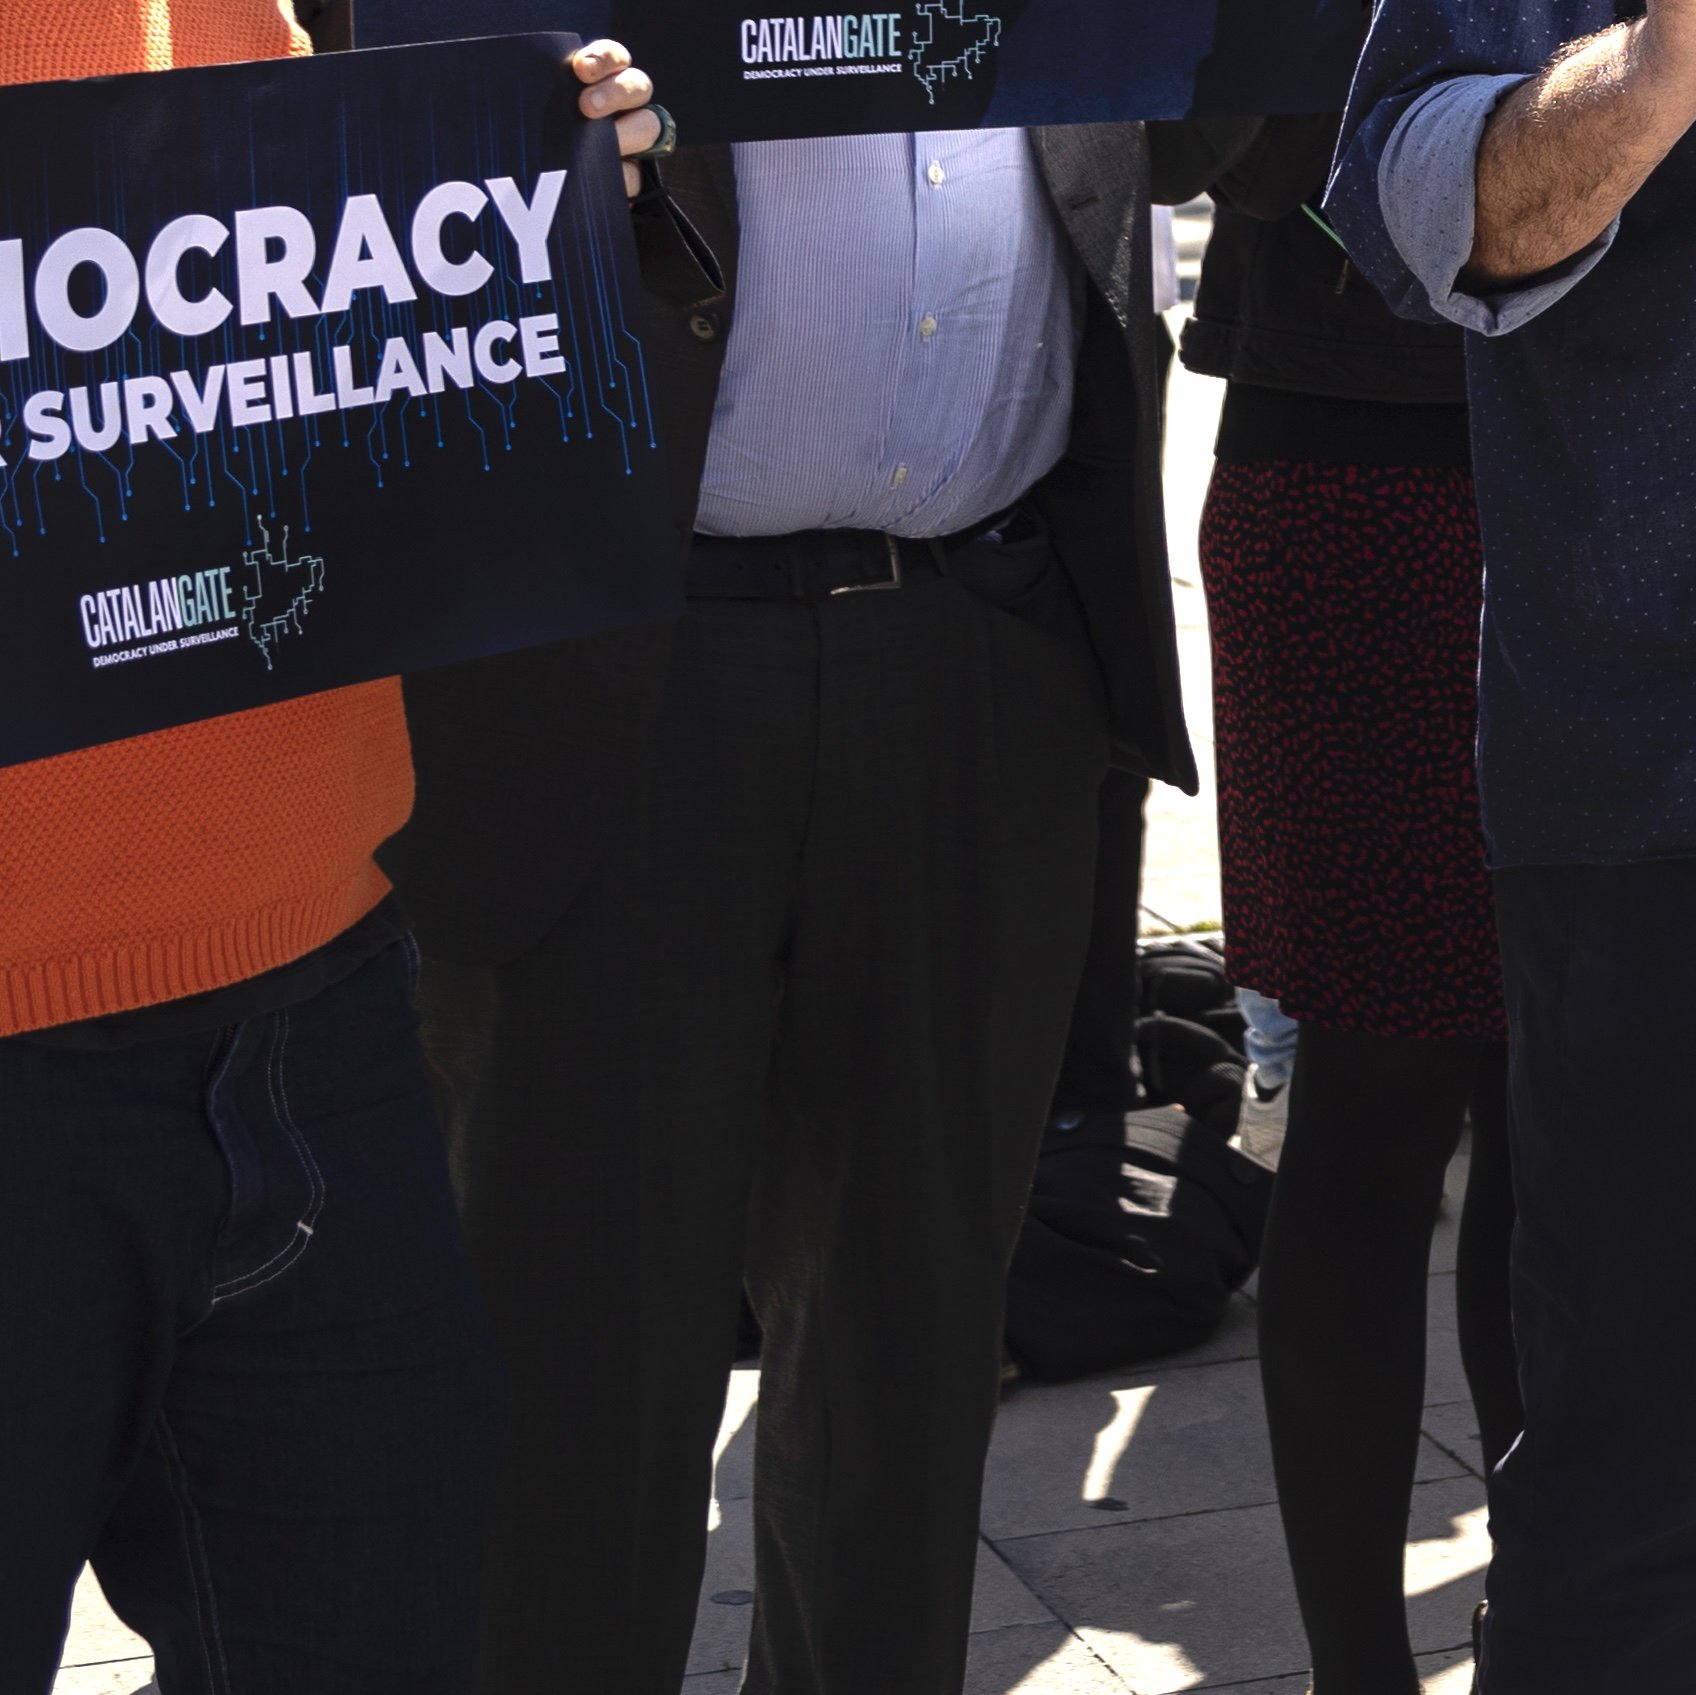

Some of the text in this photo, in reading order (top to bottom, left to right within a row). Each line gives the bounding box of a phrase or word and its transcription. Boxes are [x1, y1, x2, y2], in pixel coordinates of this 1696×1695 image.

[741, 13, 903, 64] CATALANGATE
[743, 63, 902, 80] DEMOCRACY UNDER SURVEILLANCE
[0, 169, 568, 362] OCRACY
[23, 313, 567, 461] SURVEILLANCE
[80, 566, 237, 649] CATALANGATE
[93, 626, 240, 669] DEMOCRACY UNDER SURVEILLANCE
